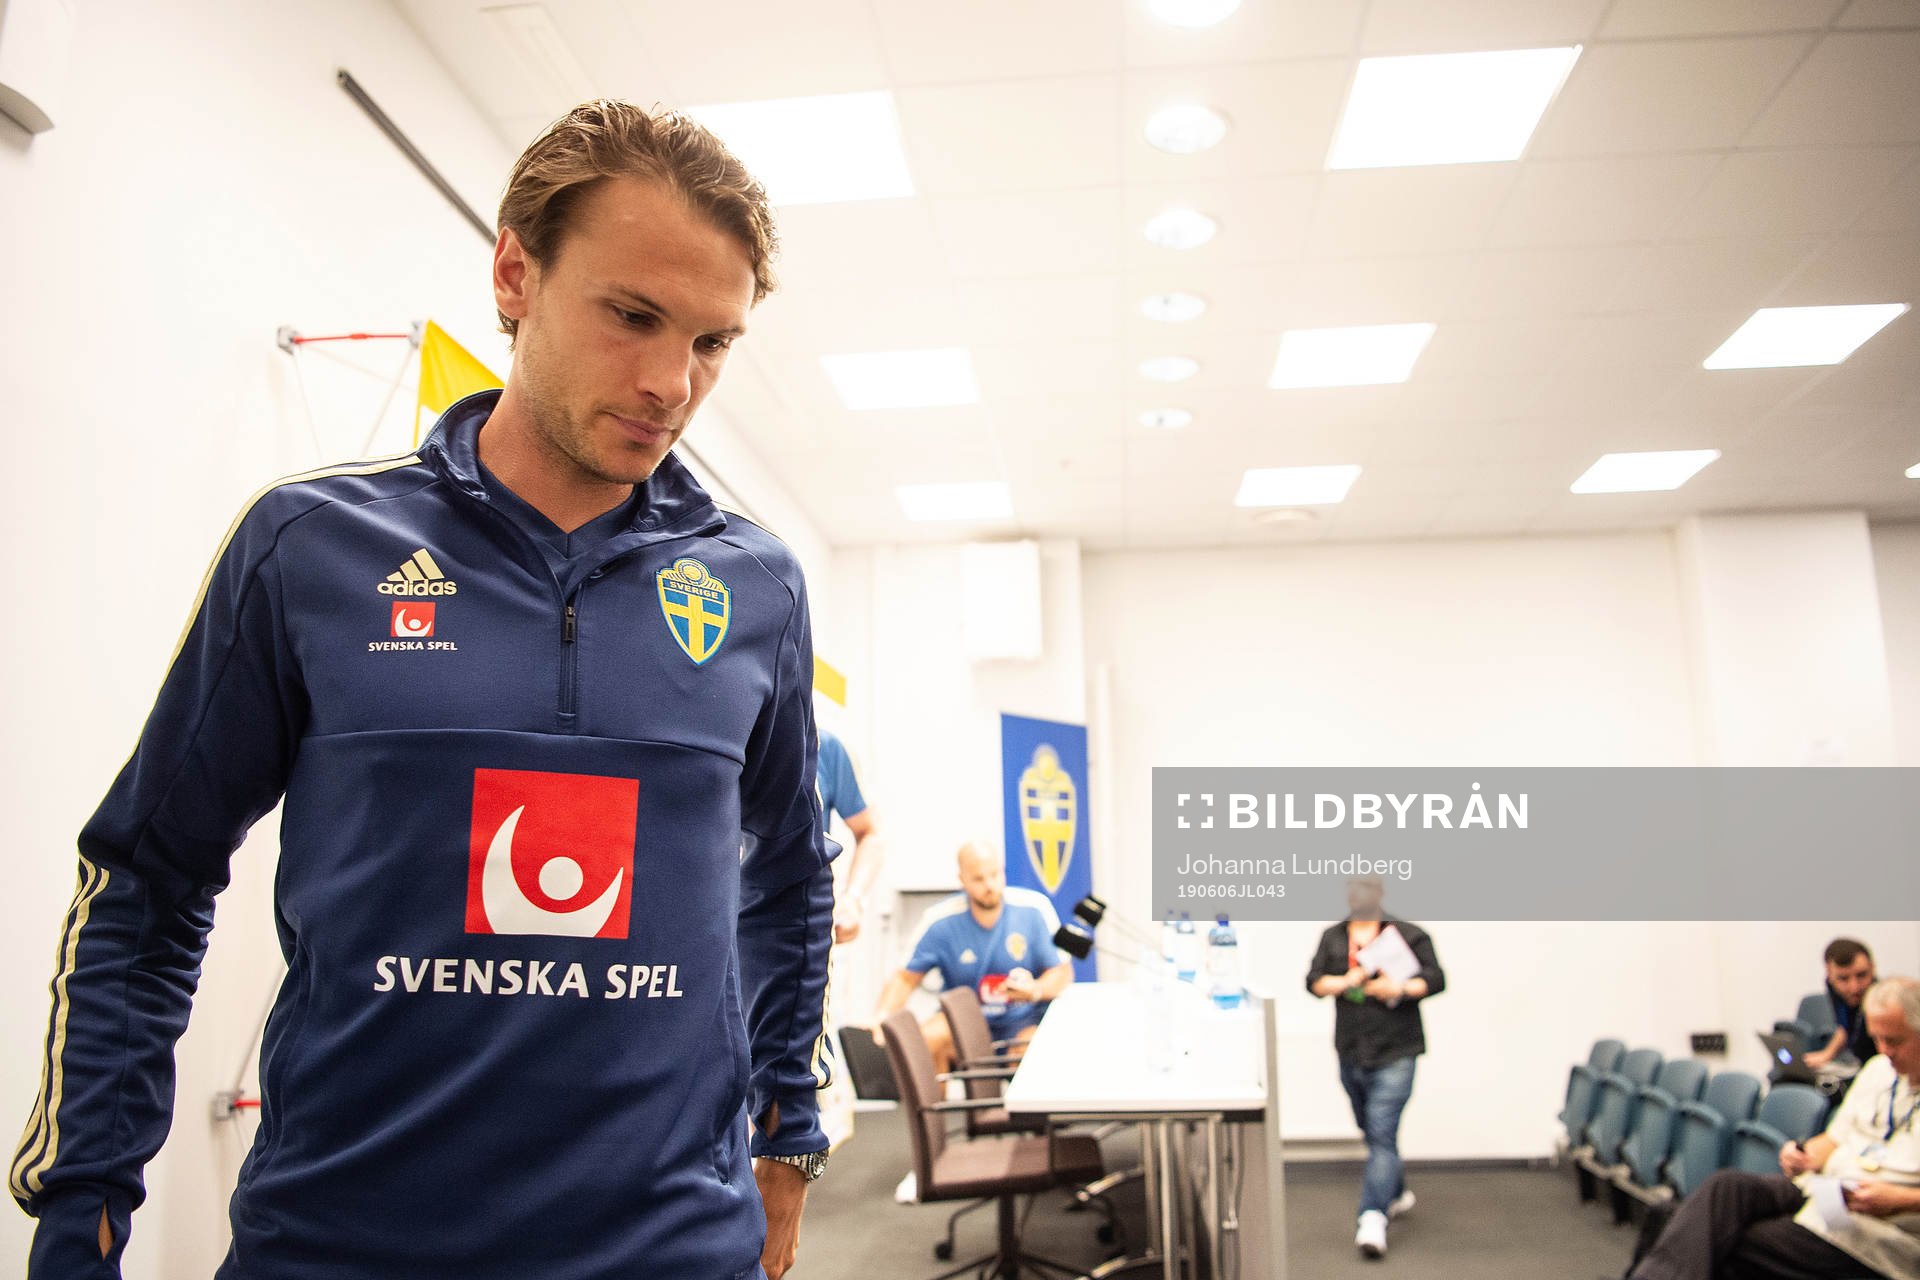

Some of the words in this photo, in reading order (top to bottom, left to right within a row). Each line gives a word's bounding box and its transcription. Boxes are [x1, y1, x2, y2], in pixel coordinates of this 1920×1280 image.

[377, 579, 457, 596] adidas
[669, 581, 720, 600] SVERIGE
[368, 641, 425, 652] SVENSKA
[427, 641, 458, 651] SPEL
[373, 955, 590, 998] SVENSKA
[604, 963, 684, 999] SPEL
